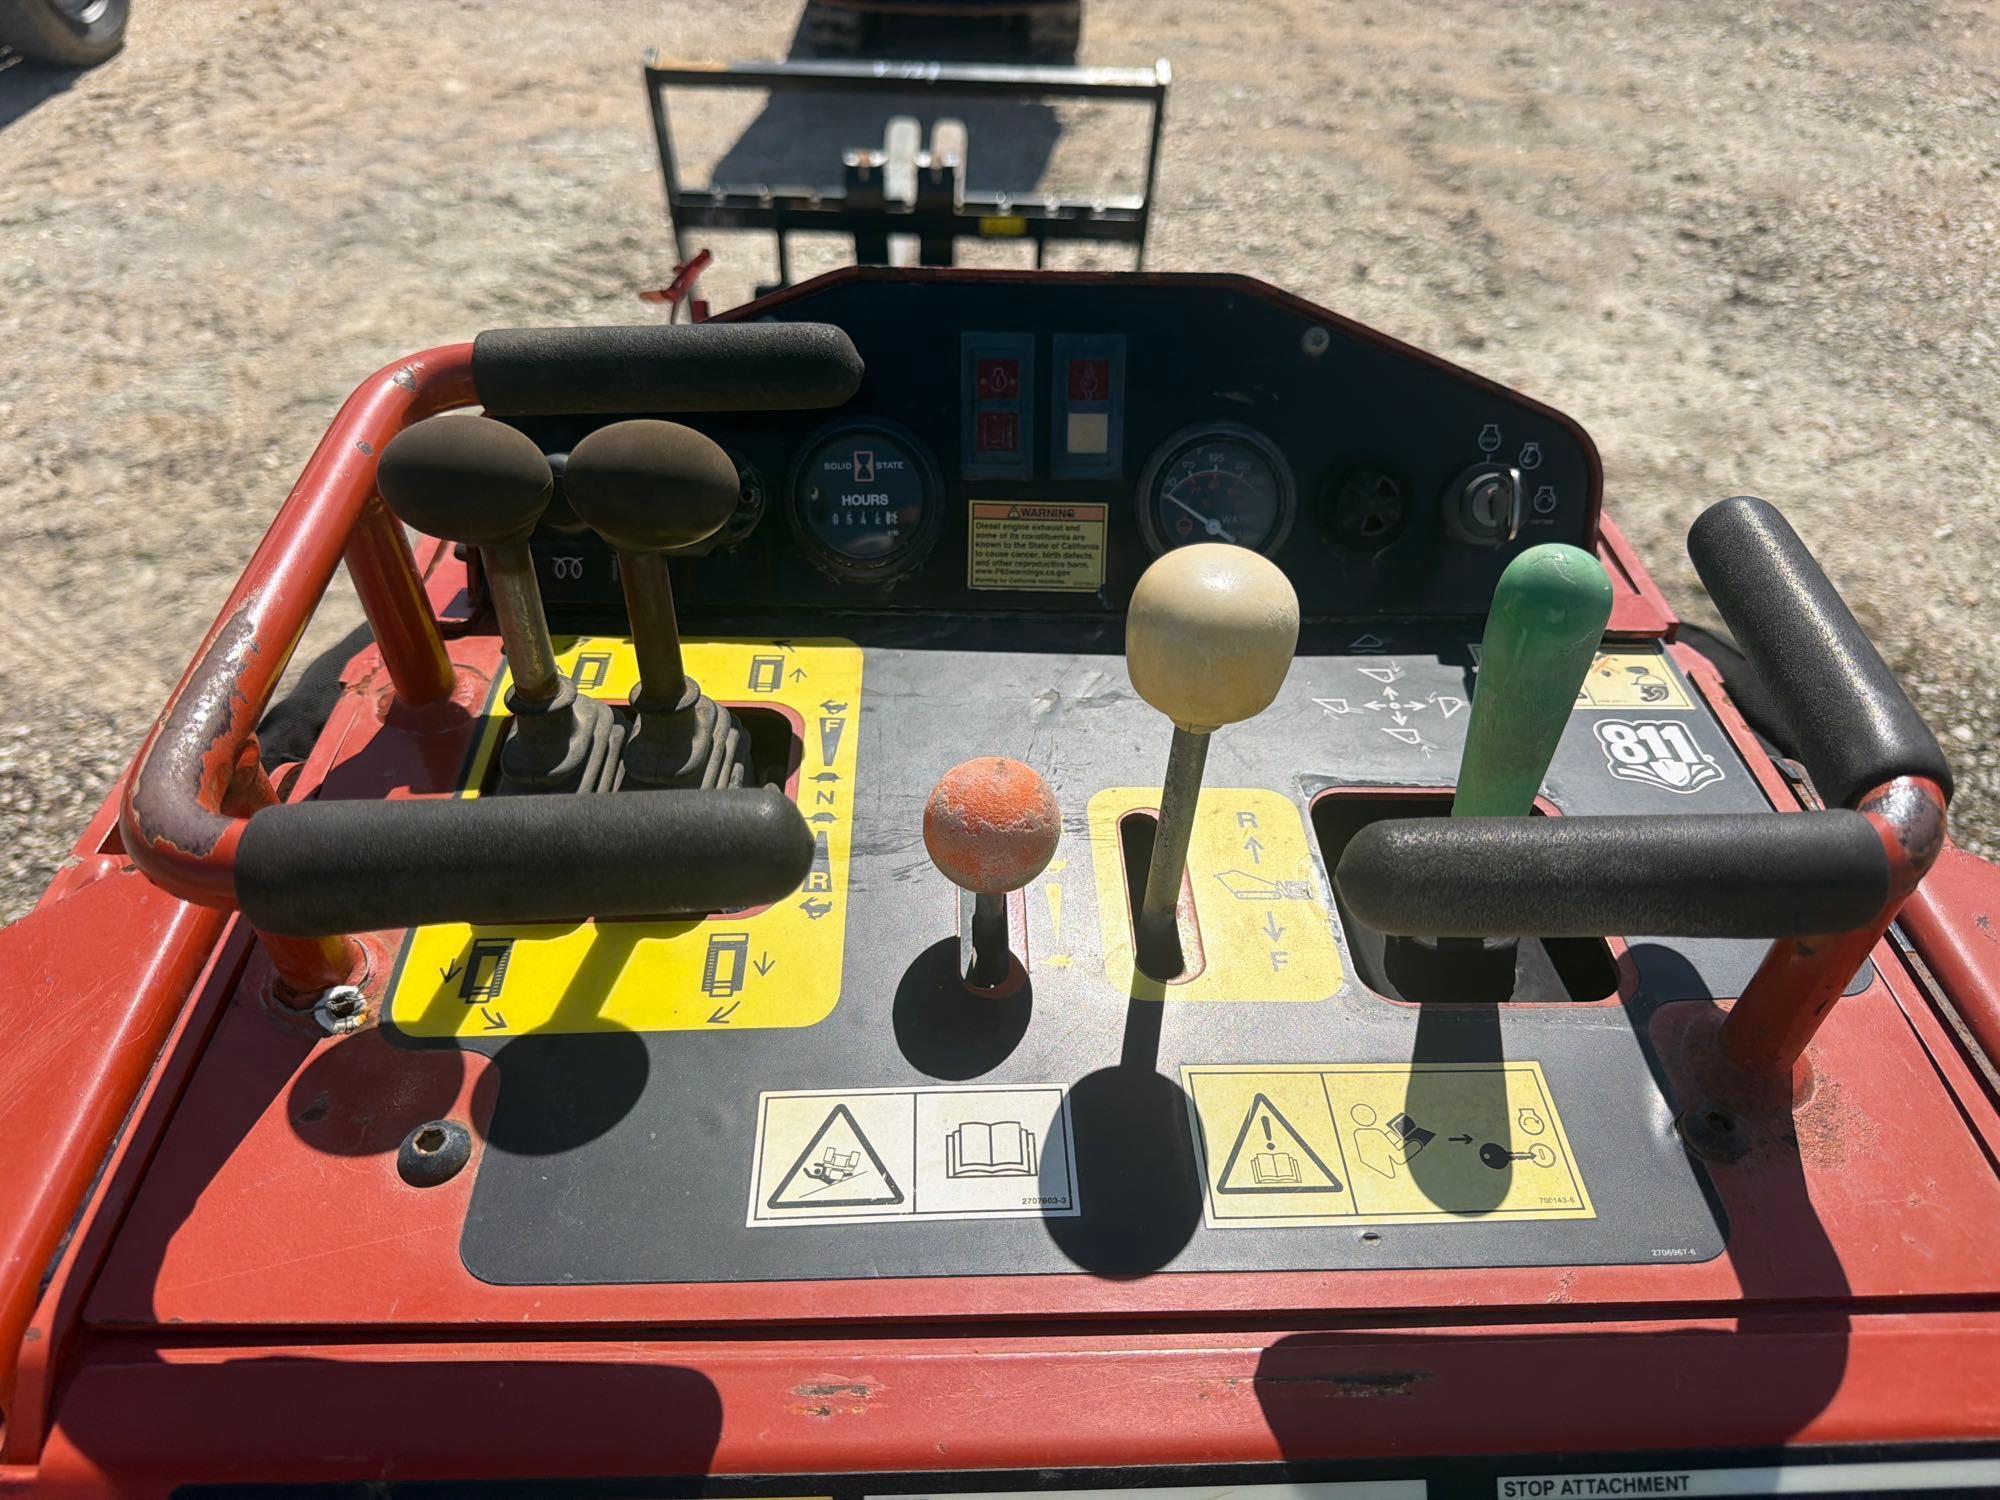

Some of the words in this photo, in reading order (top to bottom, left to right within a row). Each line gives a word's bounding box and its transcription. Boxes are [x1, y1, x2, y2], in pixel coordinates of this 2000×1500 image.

[824, 462, 853, 471] SOLID
[875, 461, 905, 470] STATE
[841, 494, 889, 506] HOURS
[1020, 508, 1075, 518] WARNING
[1003, 524, 1029, 532] engine
[1031, 523, 1064, 531] exhaust
[1021, 532, 1070, 540] constituents
[1051, 542, 1060, 550] of
[1061, 542, 1099, 550] California
[1042, 551, 1061, 559] birth
[1015, 561, 1066, 569] reproductive
[824, 719, 841, 733] F
[1601, 724, 1699, 764] 811
[816, 790, 835, 805] N
[1236, 811, 1259, 829] R
[808, 872, 829, 890] R
[1270, 951, 1288, 972] F
[1022, 1196, 1067, 1205] 2707603-3
[1539, 1196, 1575, 1204] 700143-6
[1651, 1248, 1697, 1257] 2706967-6
[1503, 1480, 1555, 1498] STOP
[1561, 1475, 1690, 1496] ATTACHMENT
